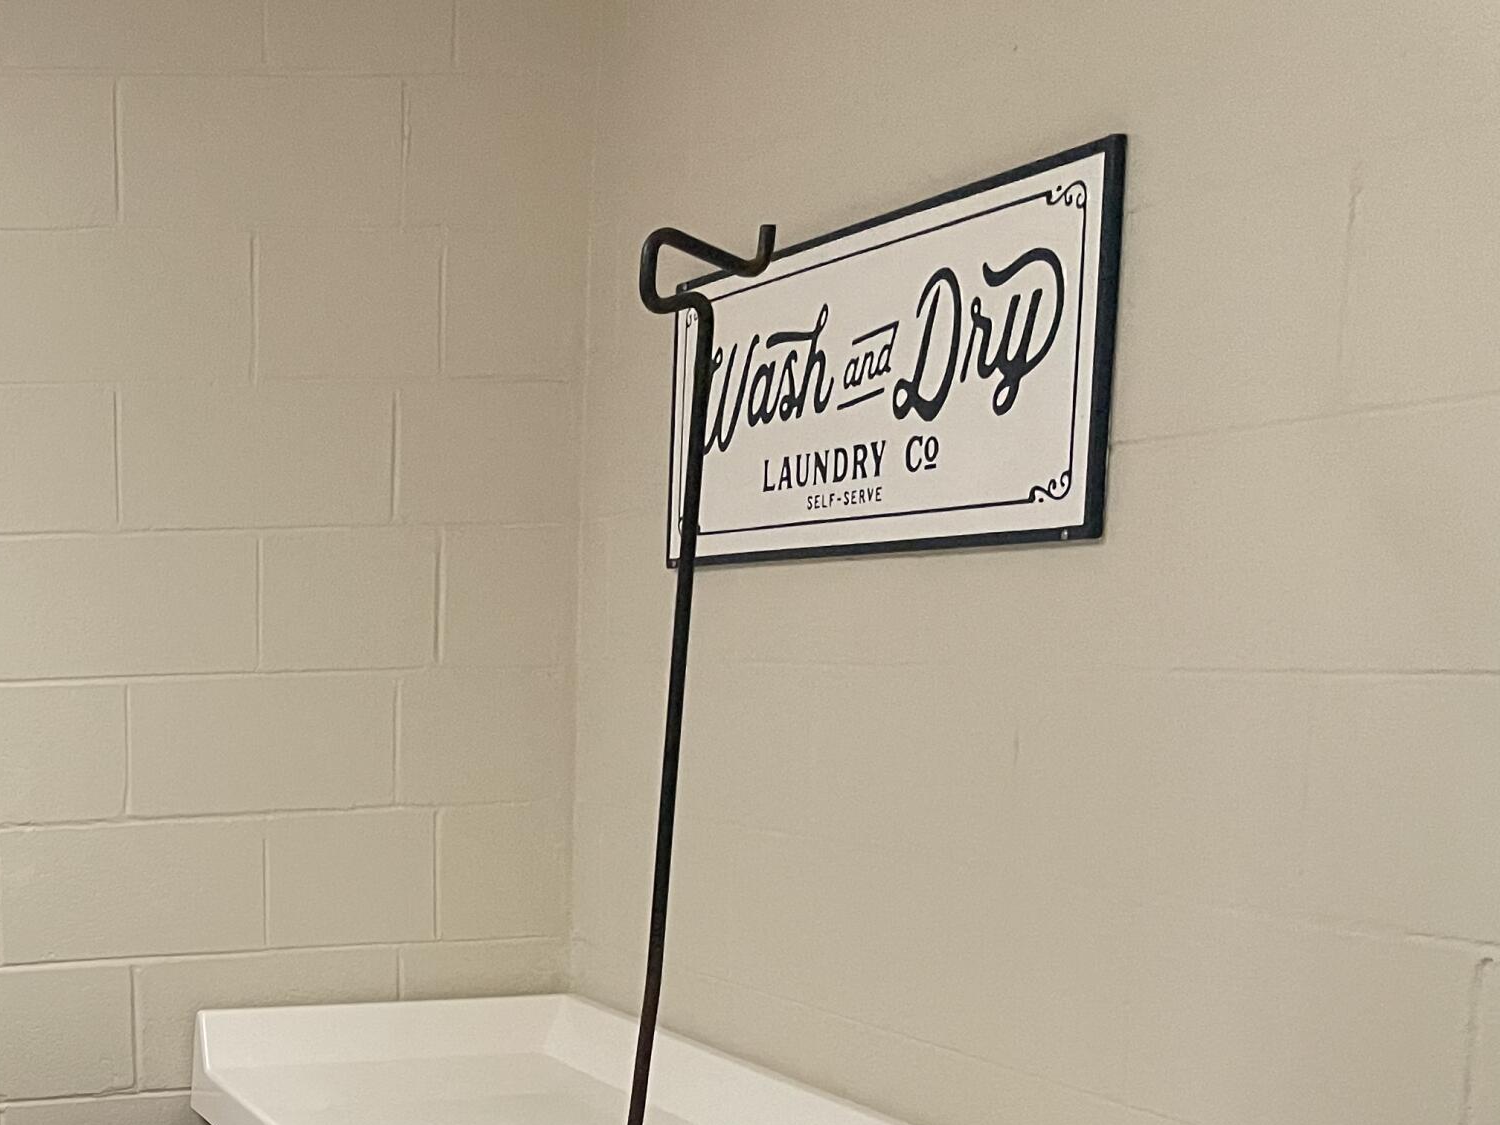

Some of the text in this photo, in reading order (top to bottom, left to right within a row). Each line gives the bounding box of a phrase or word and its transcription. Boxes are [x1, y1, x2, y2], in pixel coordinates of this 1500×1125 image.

[702, 247, 1065, 456] Wash and Dry
[763, 440, 887, 492] LAUNDRY
[806, 486, 883, 511] SELF-SERVE
